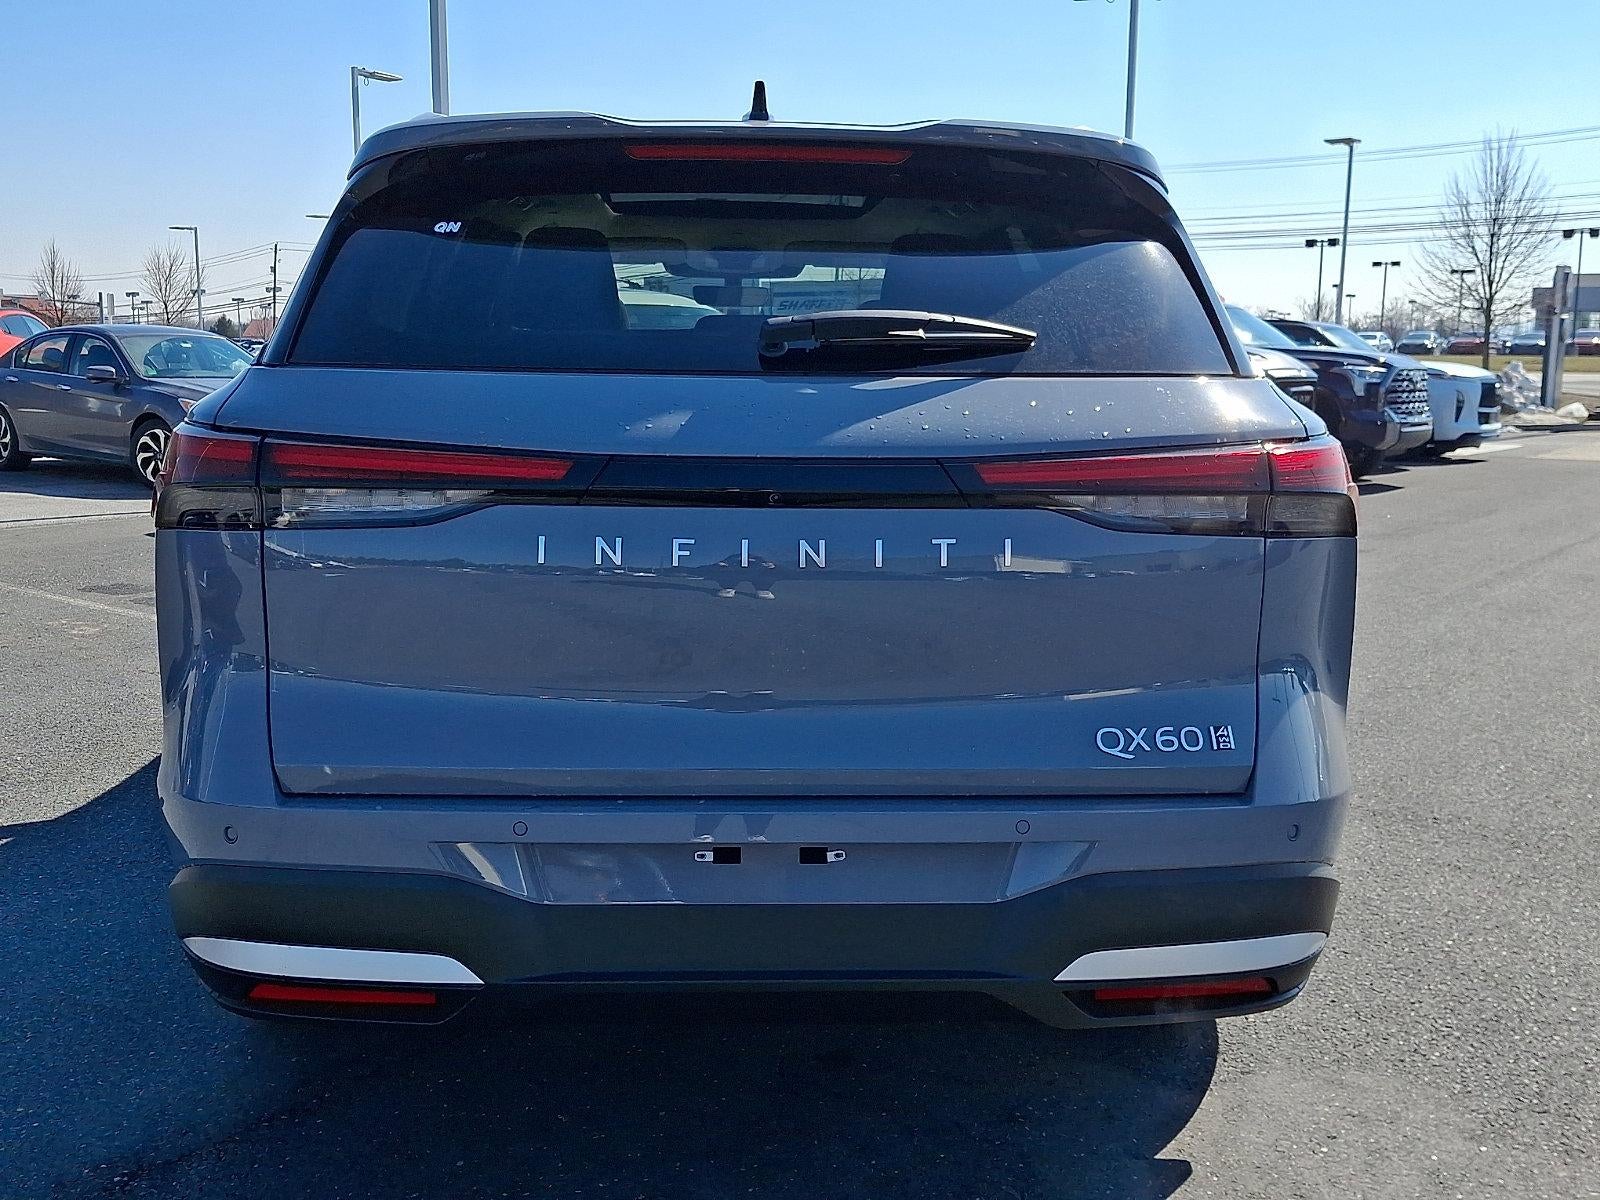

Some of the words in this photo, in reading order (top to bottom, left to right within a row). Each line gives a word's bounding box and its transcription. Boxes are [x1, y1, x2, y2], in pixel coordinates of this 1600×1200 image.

[537, 535, 1012, 568] INFINITI
[1096, 726, 1204, 759] QX60
[1216, 725, 1231, 749] AWD
